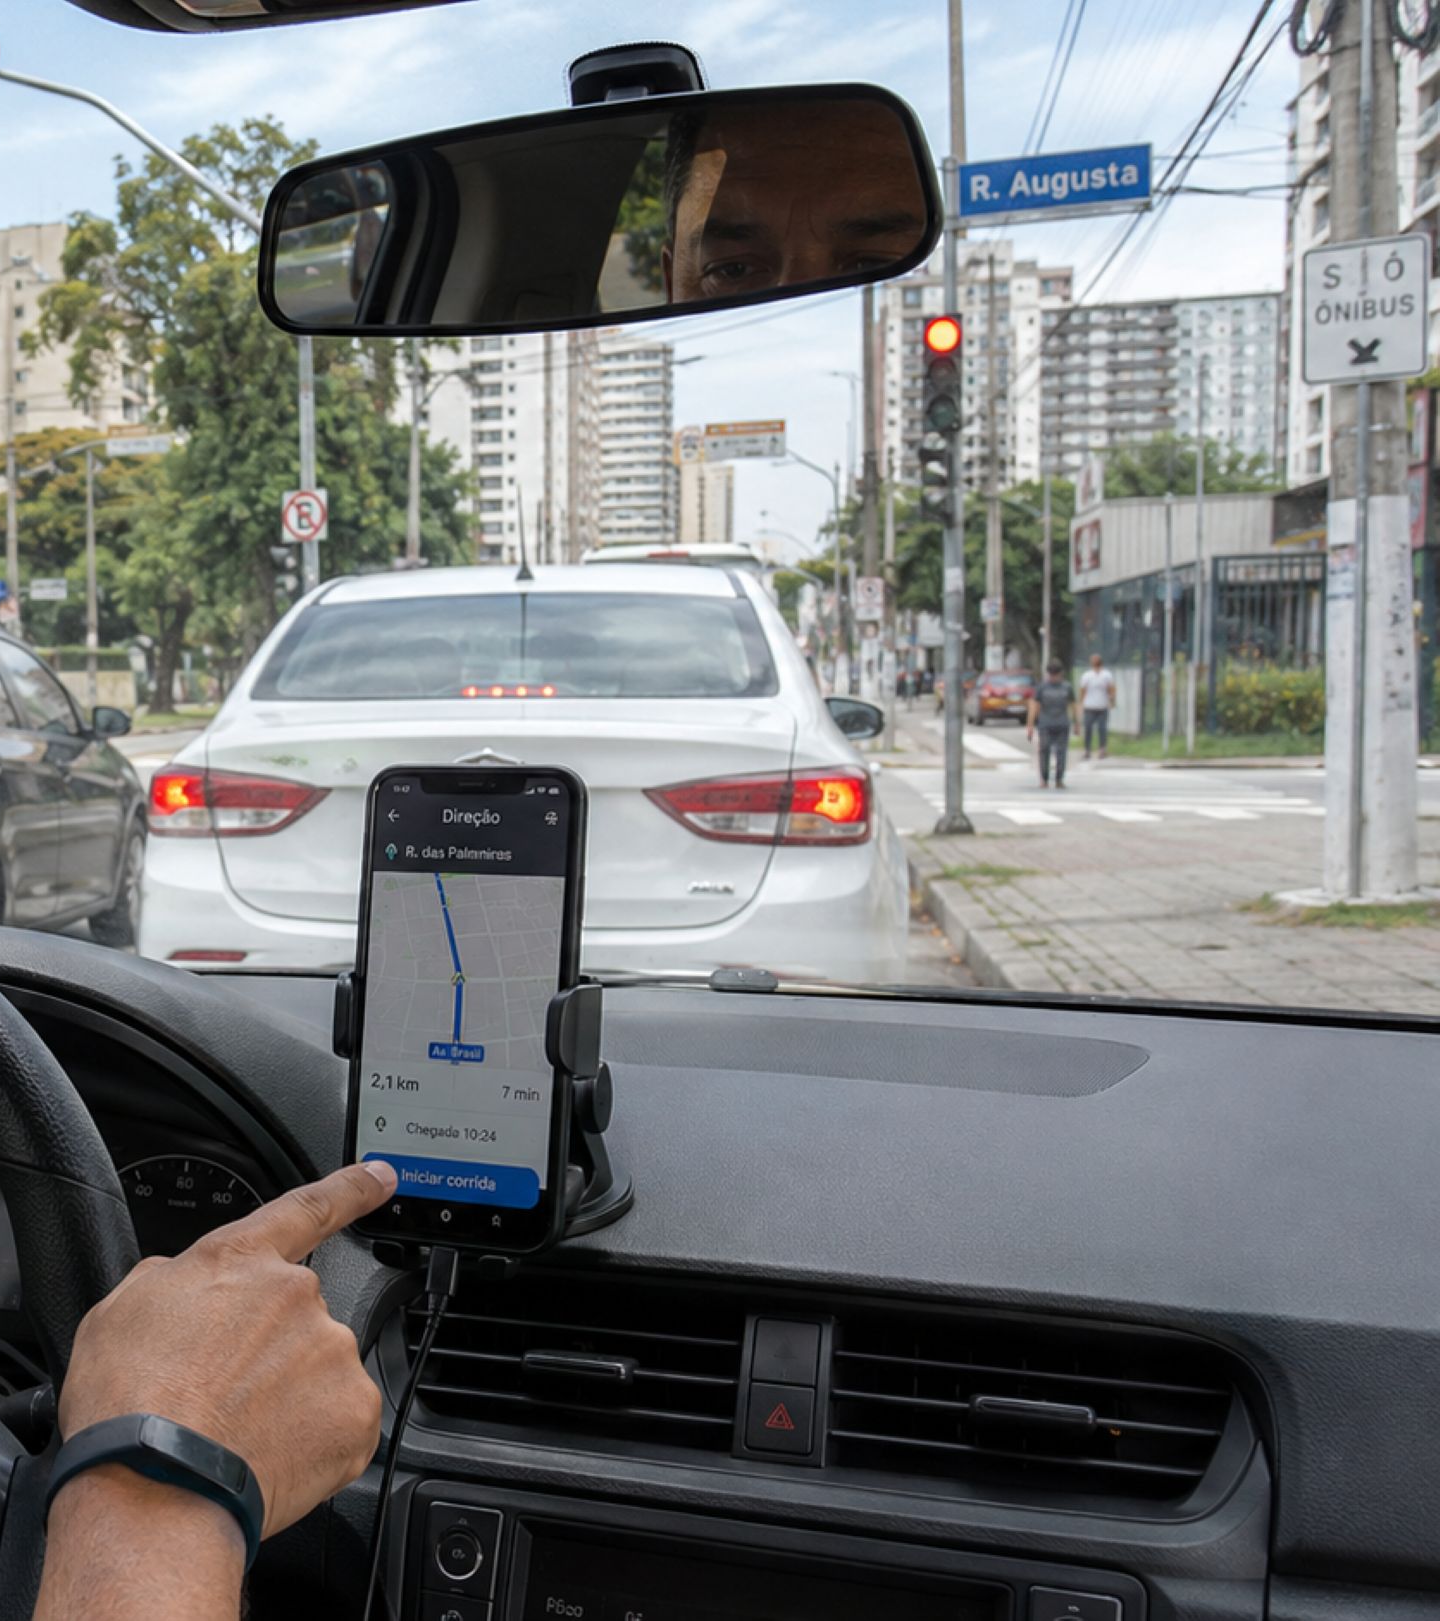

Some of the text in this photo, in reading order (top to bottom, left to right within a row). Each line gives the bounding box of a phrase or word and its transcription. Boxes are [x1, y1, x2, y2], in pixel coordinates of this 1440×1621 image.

[969, 162, 1139, 202] R. Augusta
[443, 807, 501, 828] Direção
[421, 845, 444, 859] das
[371, 1072, 419, 1092] 2,1 km
[502, 1085, 540, 1101] 7 min
[446, 1174, 497, 1192] corrida
